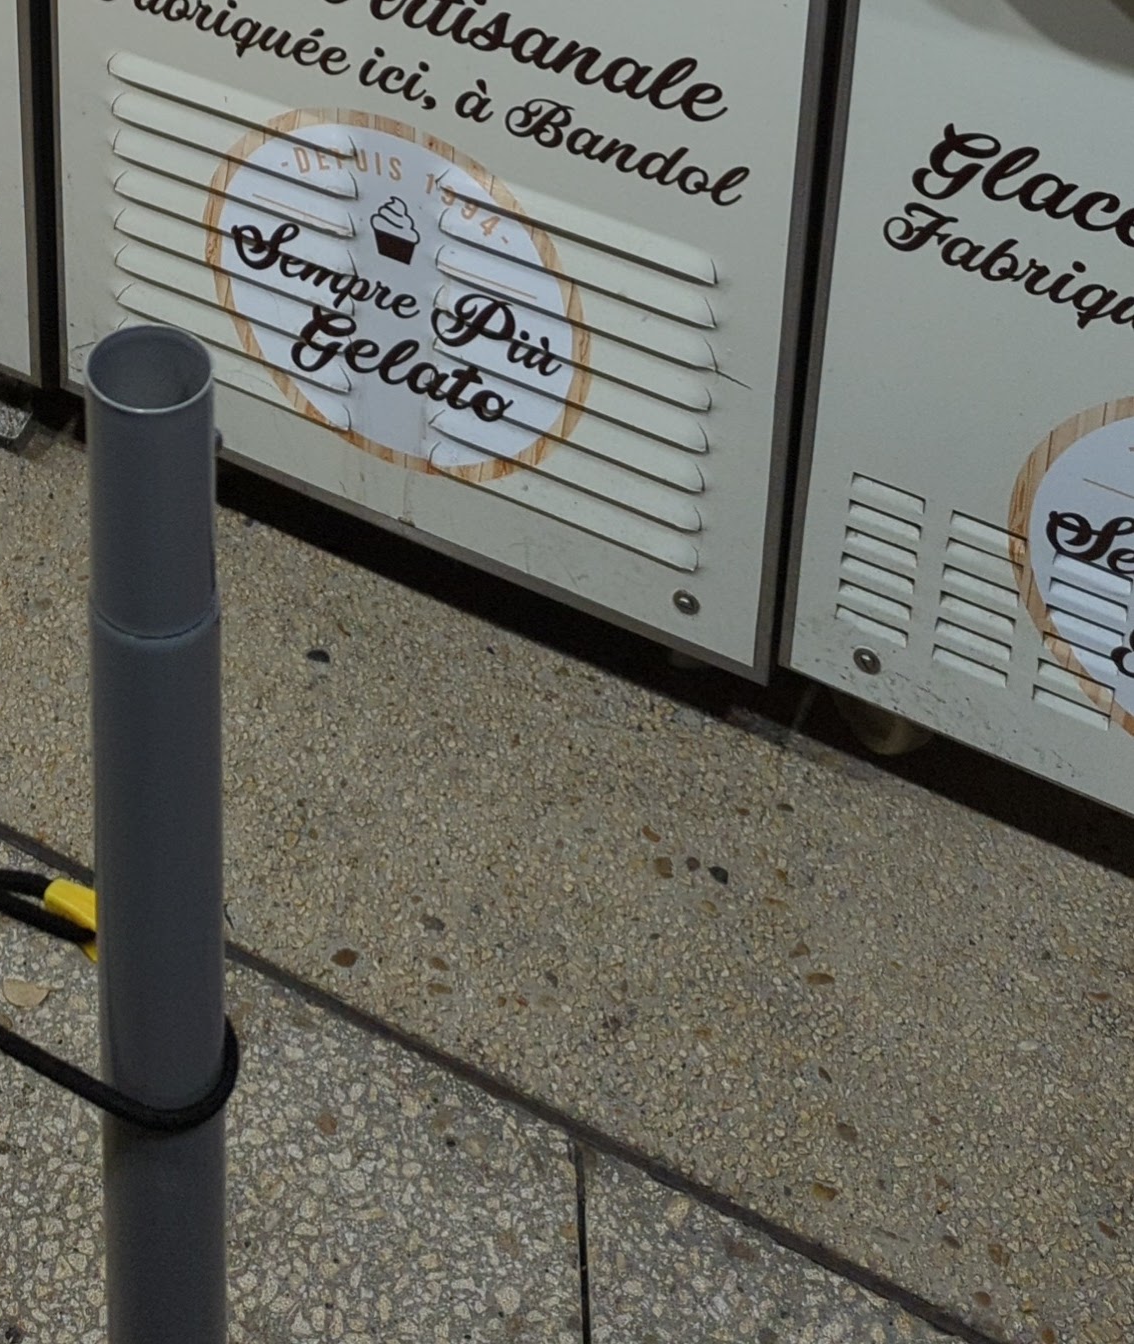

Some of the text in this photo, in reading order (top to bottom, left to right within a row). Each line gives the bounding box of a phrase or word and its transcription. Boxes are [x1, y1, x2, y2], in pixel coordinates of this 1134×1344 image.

[358, 47, 438, 110] ici,
[455, 79, 493, 124] à
[505, 98, 751, 207] Bandol
[232, 223, 563, 378] Sempre Più
[291, 305, 515, 423] Gelato
